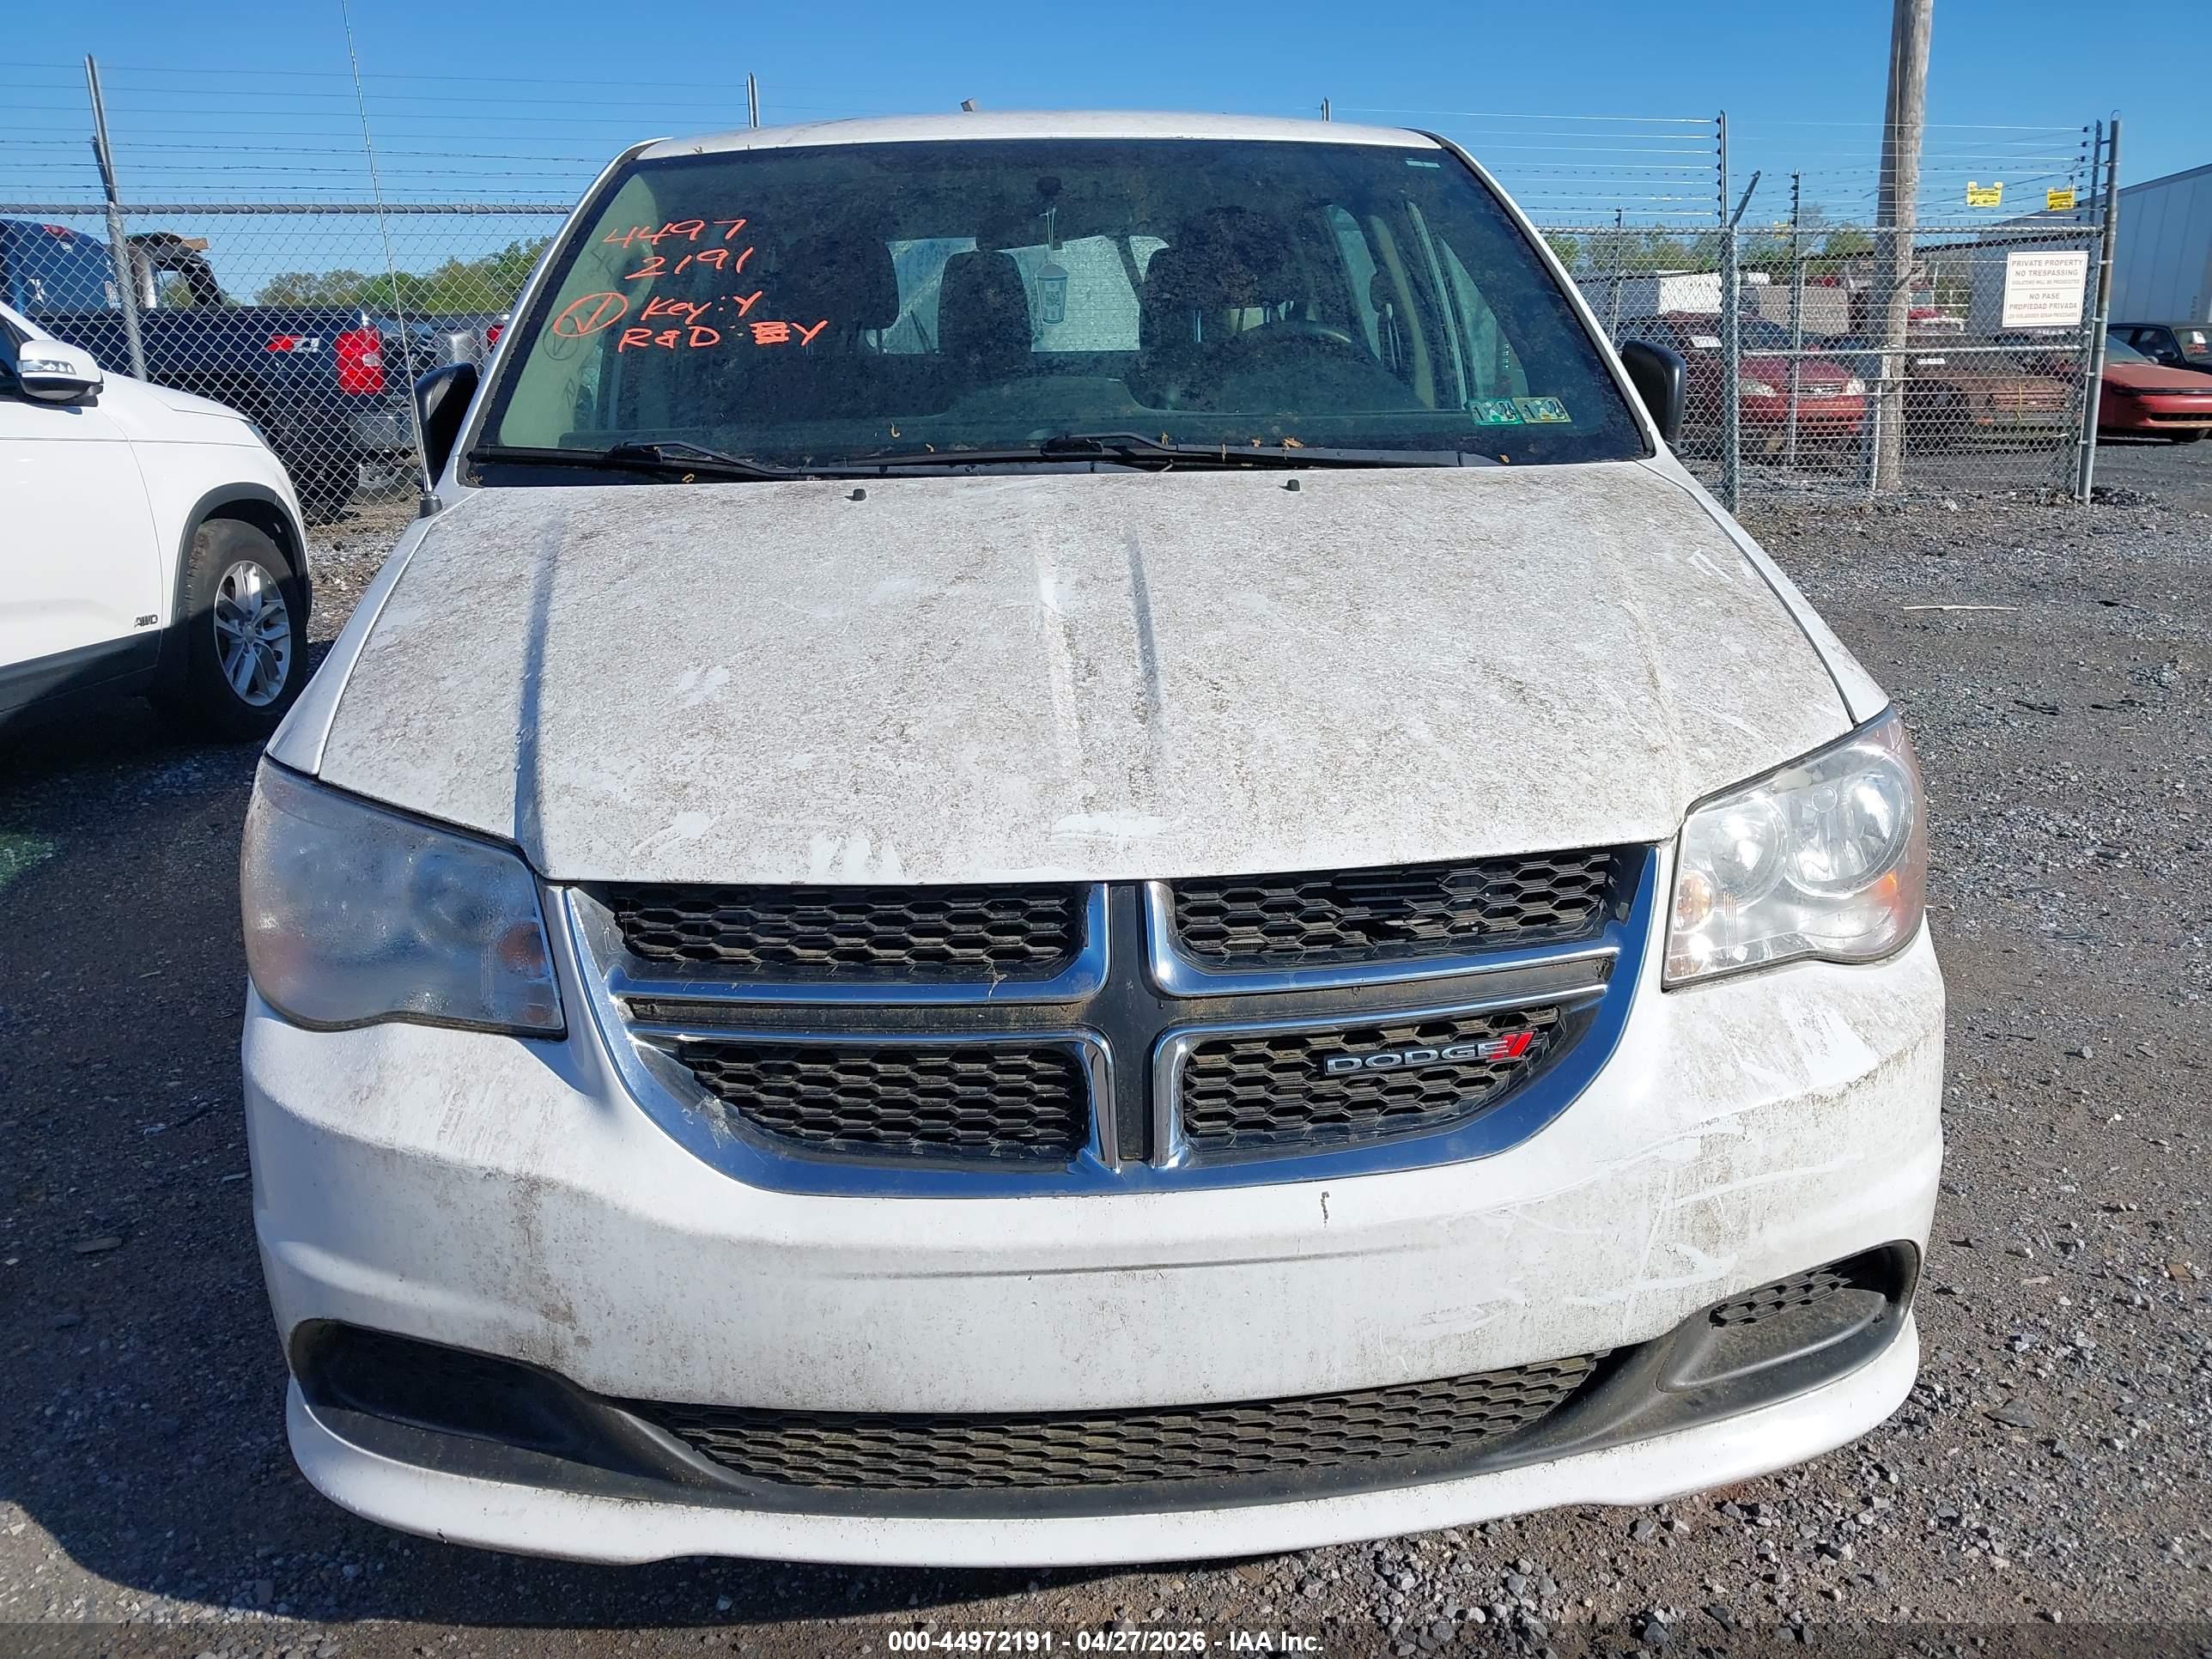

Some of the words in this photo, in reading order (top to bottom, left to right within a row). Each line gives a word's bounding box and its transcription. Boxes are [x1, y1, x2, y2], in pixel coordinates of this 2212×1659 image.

[603, 218, 747, 249] 4497
[623, 246, 754, 280] 2191
[134, 614, 158, 628] AWD
[1326, 1039, 1509, 1073] DODGE
